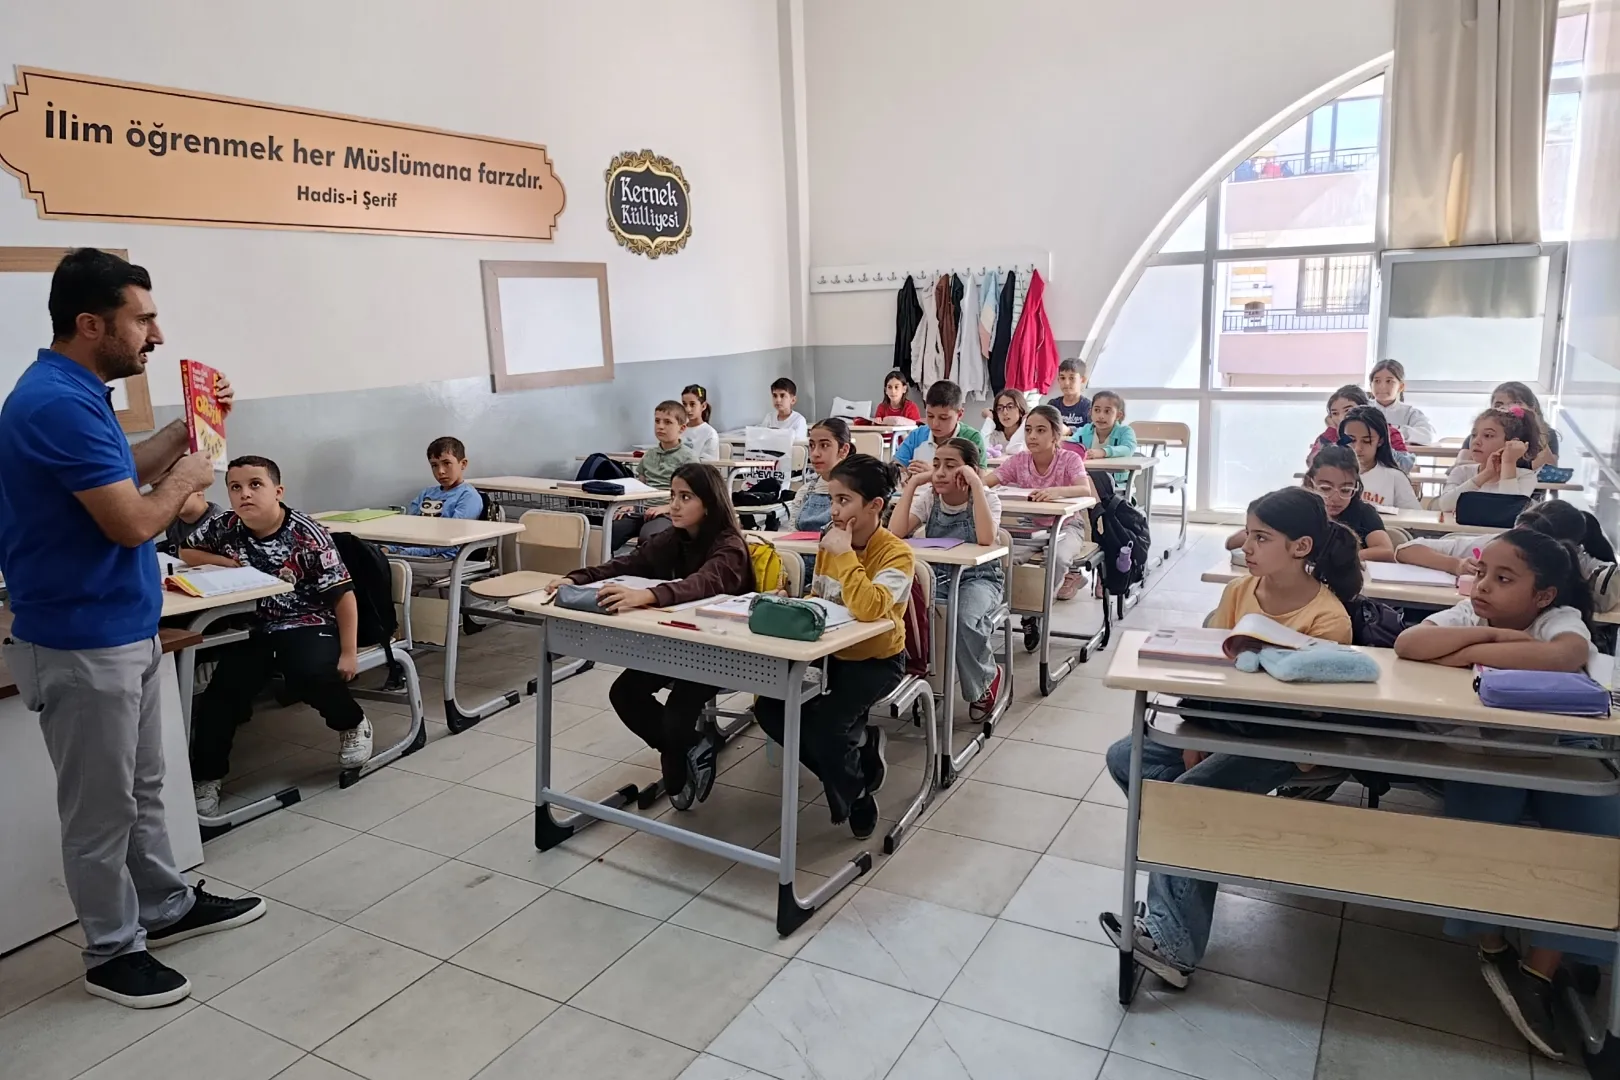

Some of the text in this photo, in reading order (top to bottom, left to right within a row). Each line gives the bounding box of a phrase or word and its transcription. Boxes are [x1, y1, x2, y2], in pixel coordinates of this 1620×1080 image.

[46, 101, 543, 190] İlim öğrenmek her Müslümana farzdır.
[297, 185, 398, 210] Hadis-i Şerif
[620, 176, 679, 207] Kernek
[621, 204, 680, 232] Külliyesi
